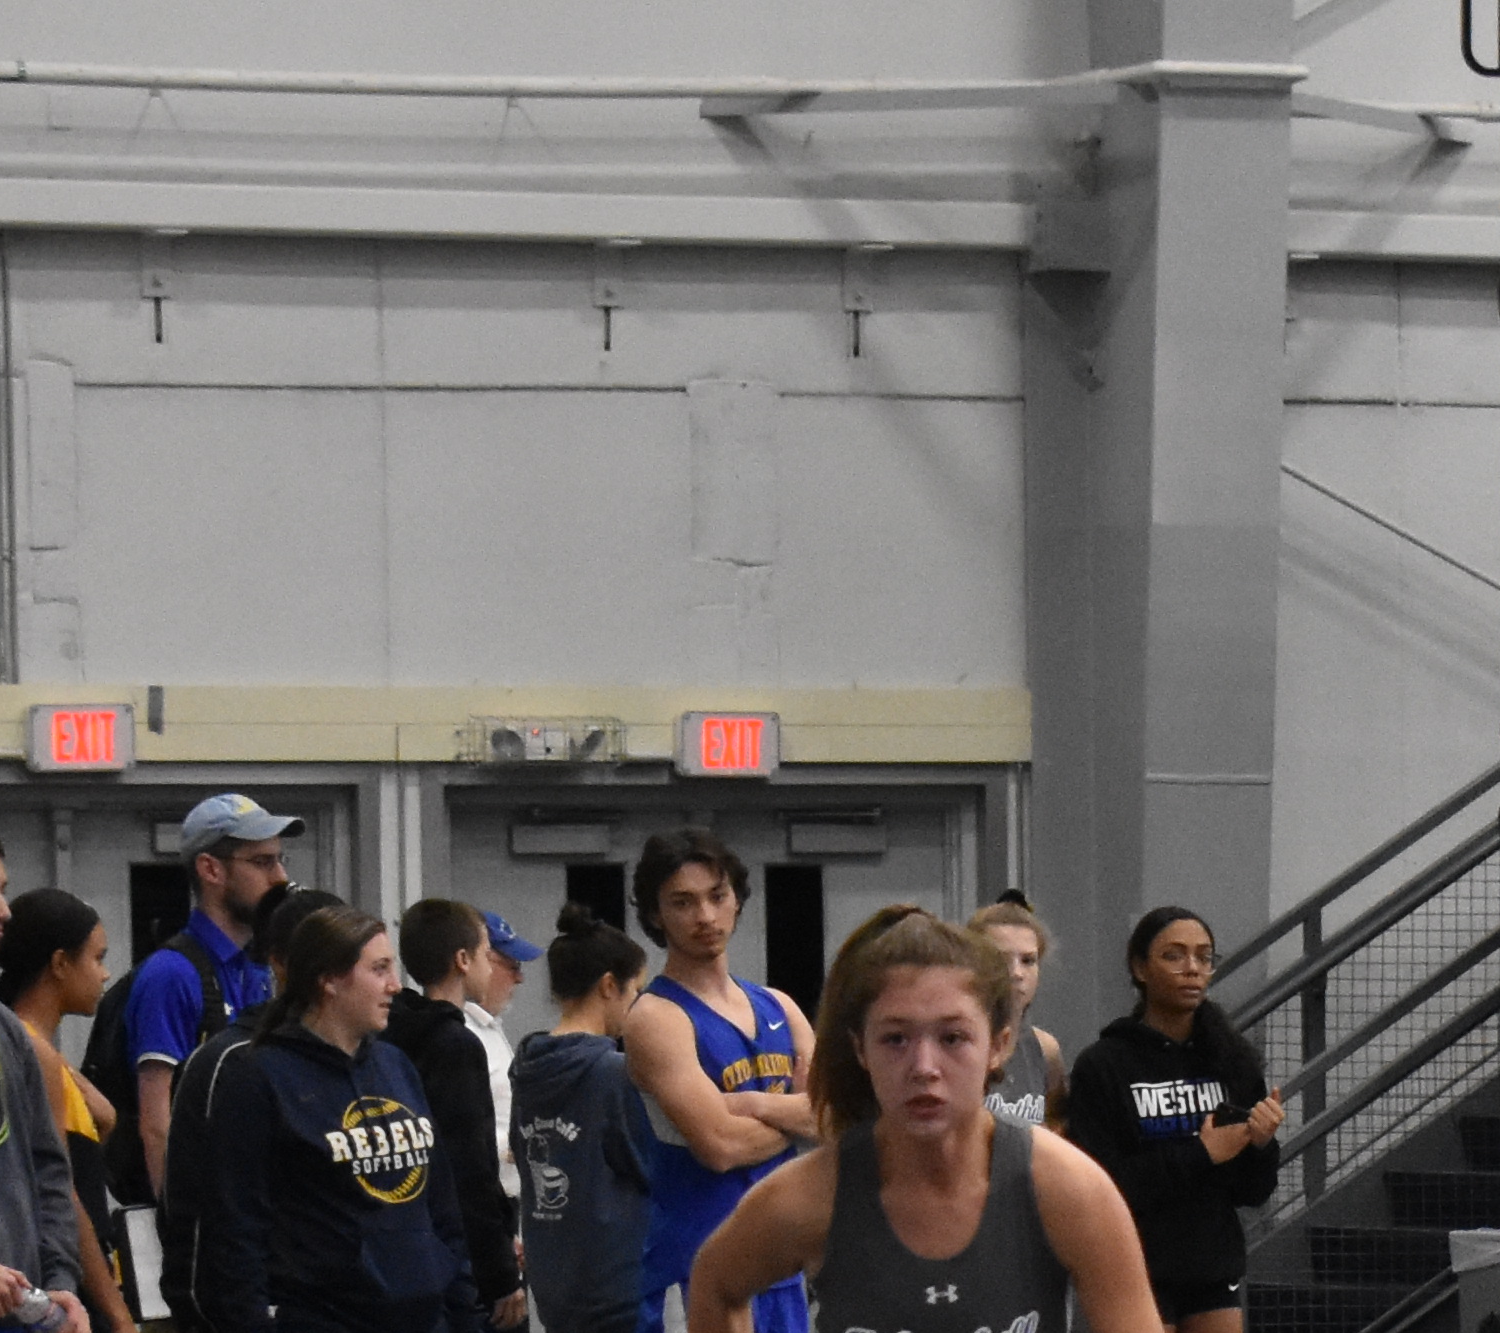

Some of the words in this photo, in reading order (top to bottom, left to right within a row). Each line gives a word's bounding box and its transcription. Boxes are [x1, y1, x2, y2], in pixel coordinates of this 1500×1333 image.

[52, 711, 117, 763] EXIT
[702, 718, 765, 769] EXIT
[325, 1117, 435, 1163] REBELS
[352, 1150, 430, 1175] SOFTBALL
